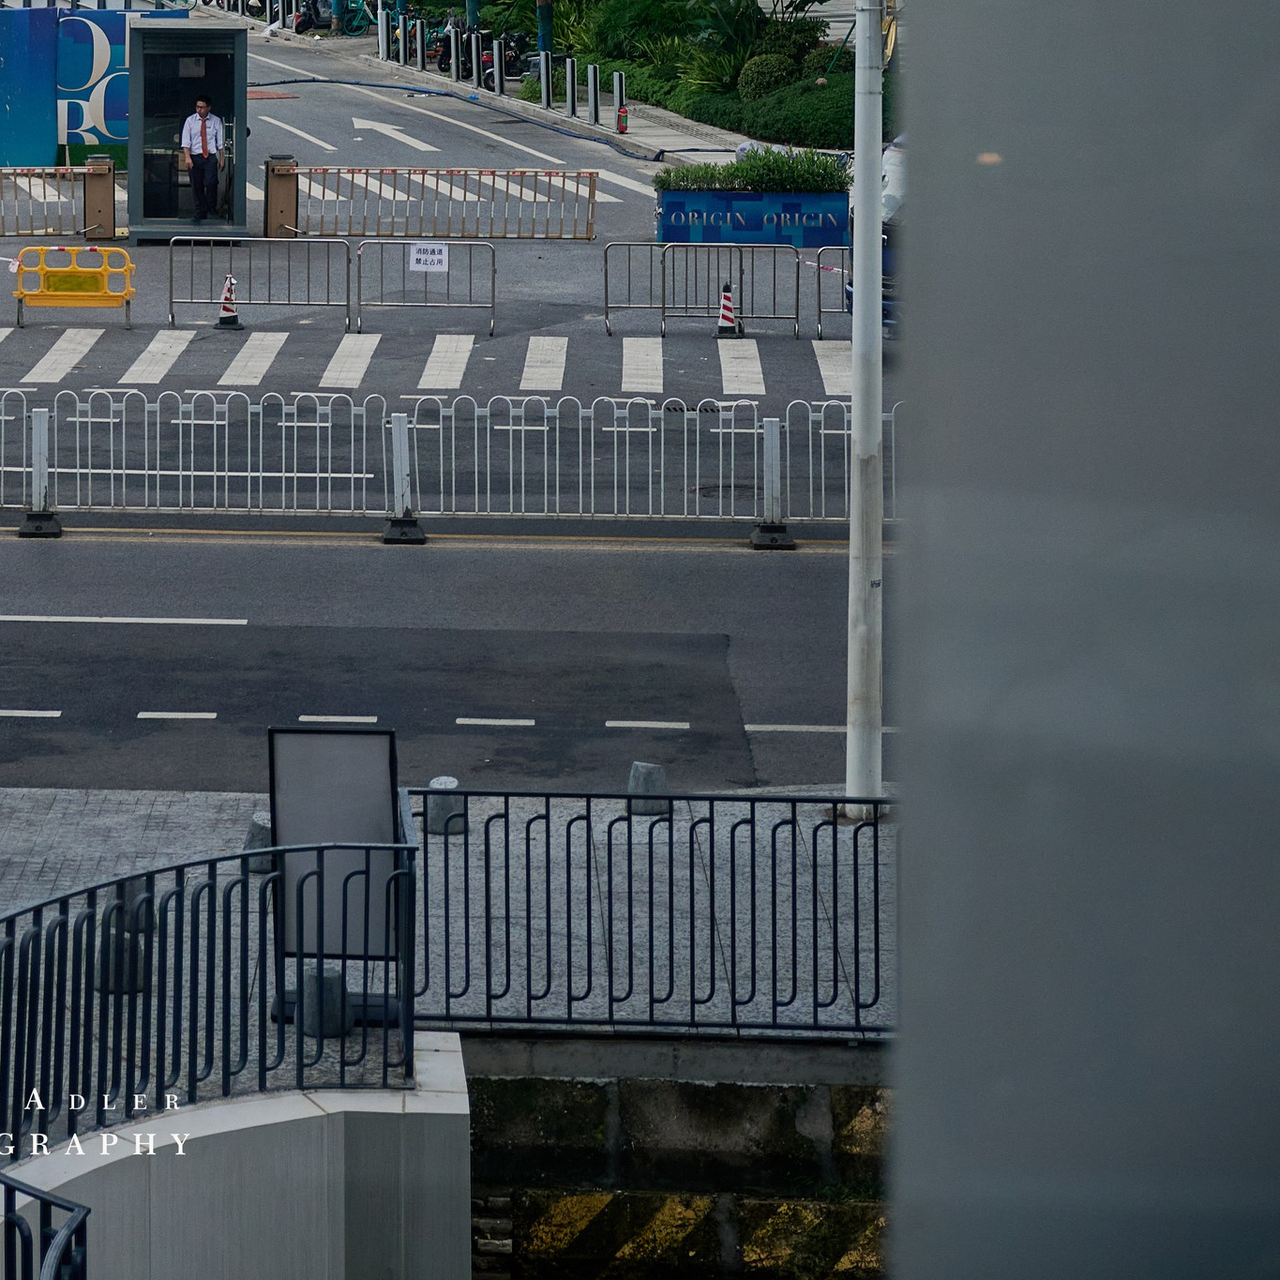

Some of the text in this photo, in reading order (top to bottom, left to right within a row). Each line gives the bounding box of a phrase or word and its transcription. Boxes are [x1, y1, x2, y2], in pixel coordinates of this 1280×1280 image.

[671, 211, 838, 227] ORIGIN ORIGIN
[415, 258, 443, 266] 禁止占用
